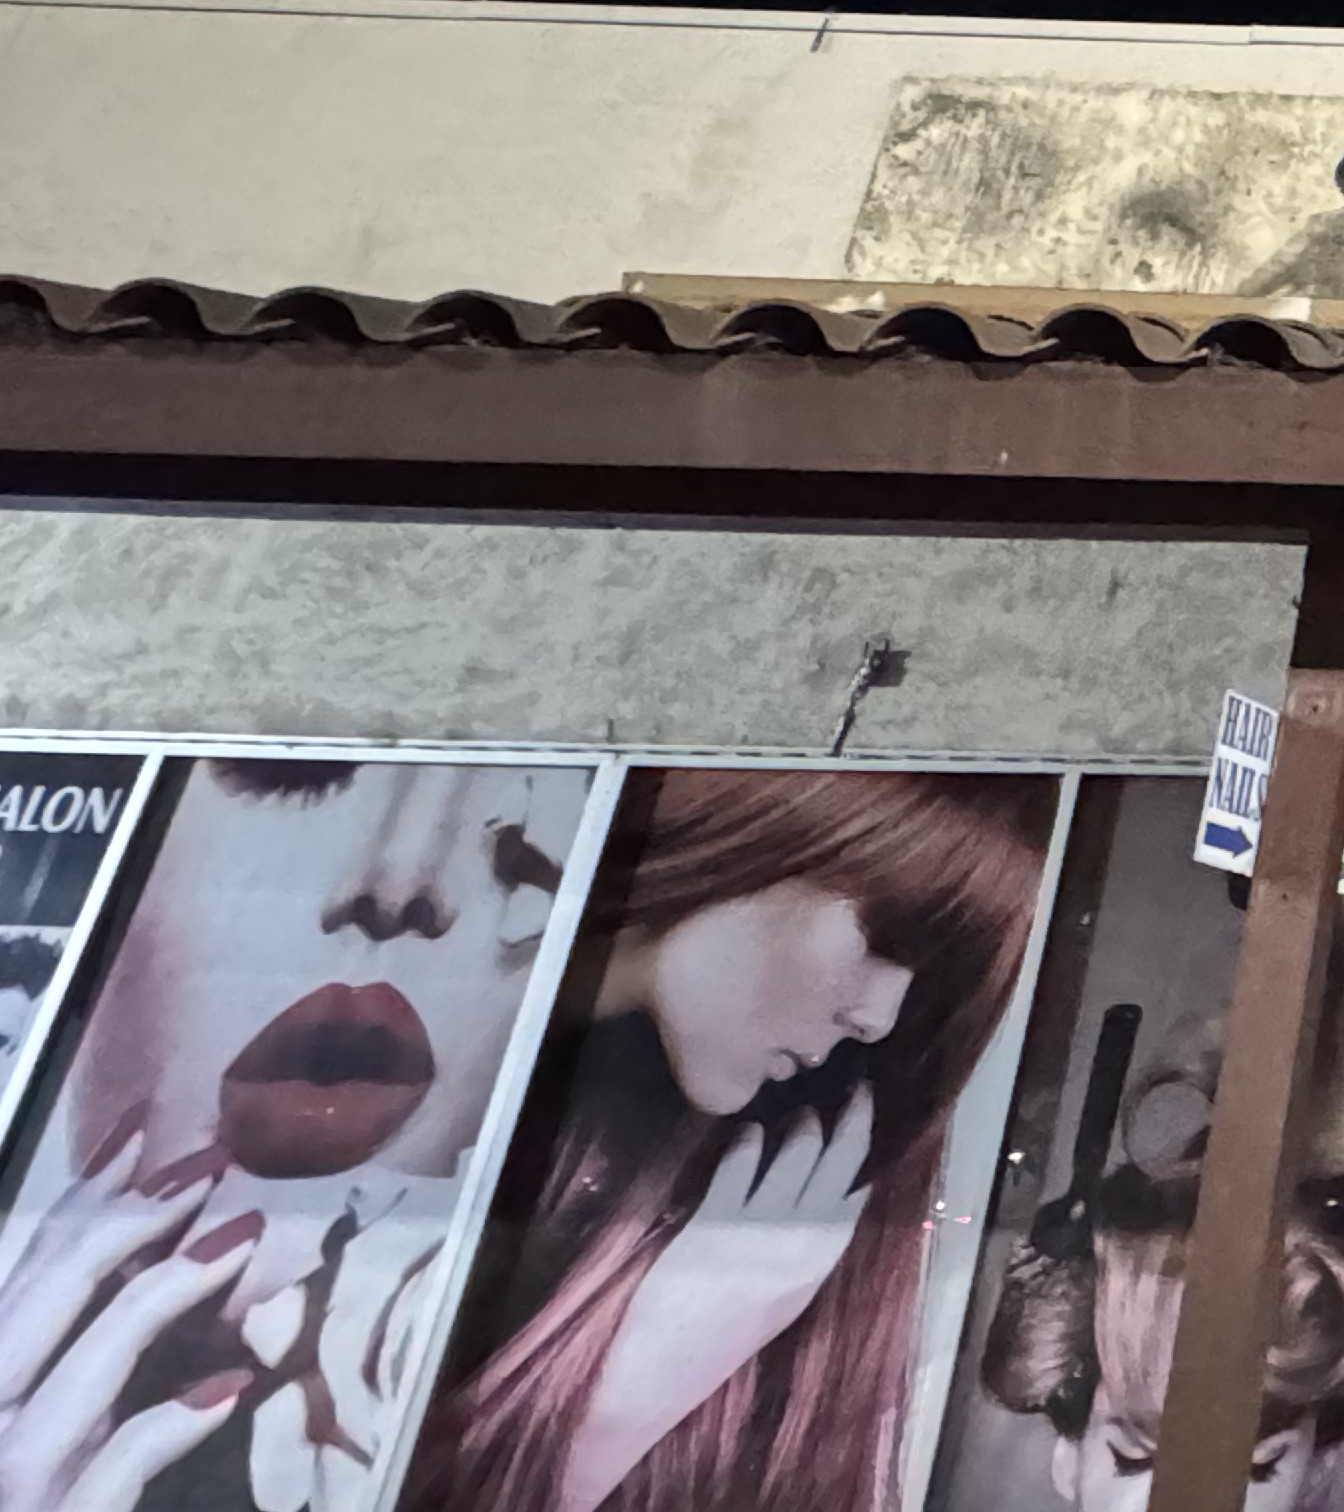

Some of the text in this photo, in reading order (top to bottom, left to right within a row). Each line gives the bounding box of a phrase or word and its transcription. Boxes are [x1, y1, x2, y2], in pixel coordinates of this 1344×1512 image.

[1221, 695, 1274, 762] HAIR
[0, 784, 124, 834] ALON
[1208, 756, 1268, 822] NAILS
